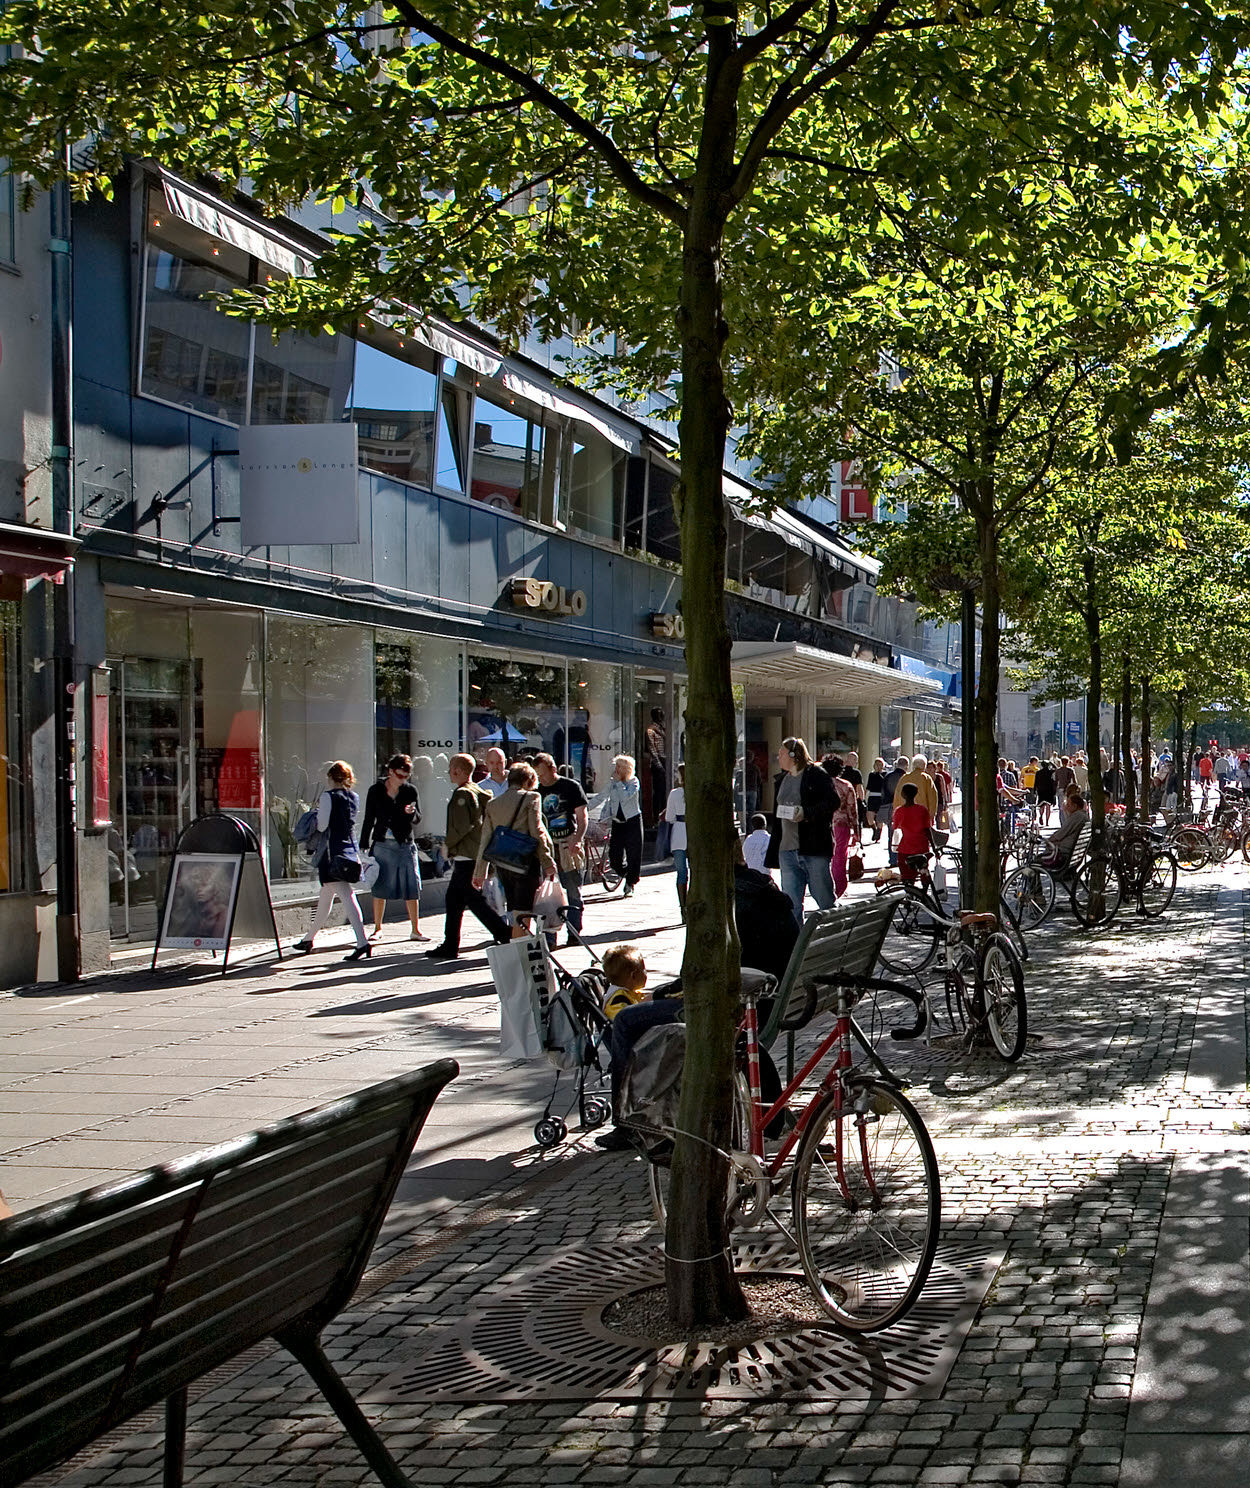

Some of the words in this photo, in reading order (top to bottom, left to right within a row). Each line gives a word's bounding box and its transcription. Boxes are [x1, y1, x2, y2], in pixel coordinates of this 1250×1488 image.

[524, 578, 587, 617] SOLO
[663, 613, 685, 639] SO
[418, 740, 453, 748] SOLO
